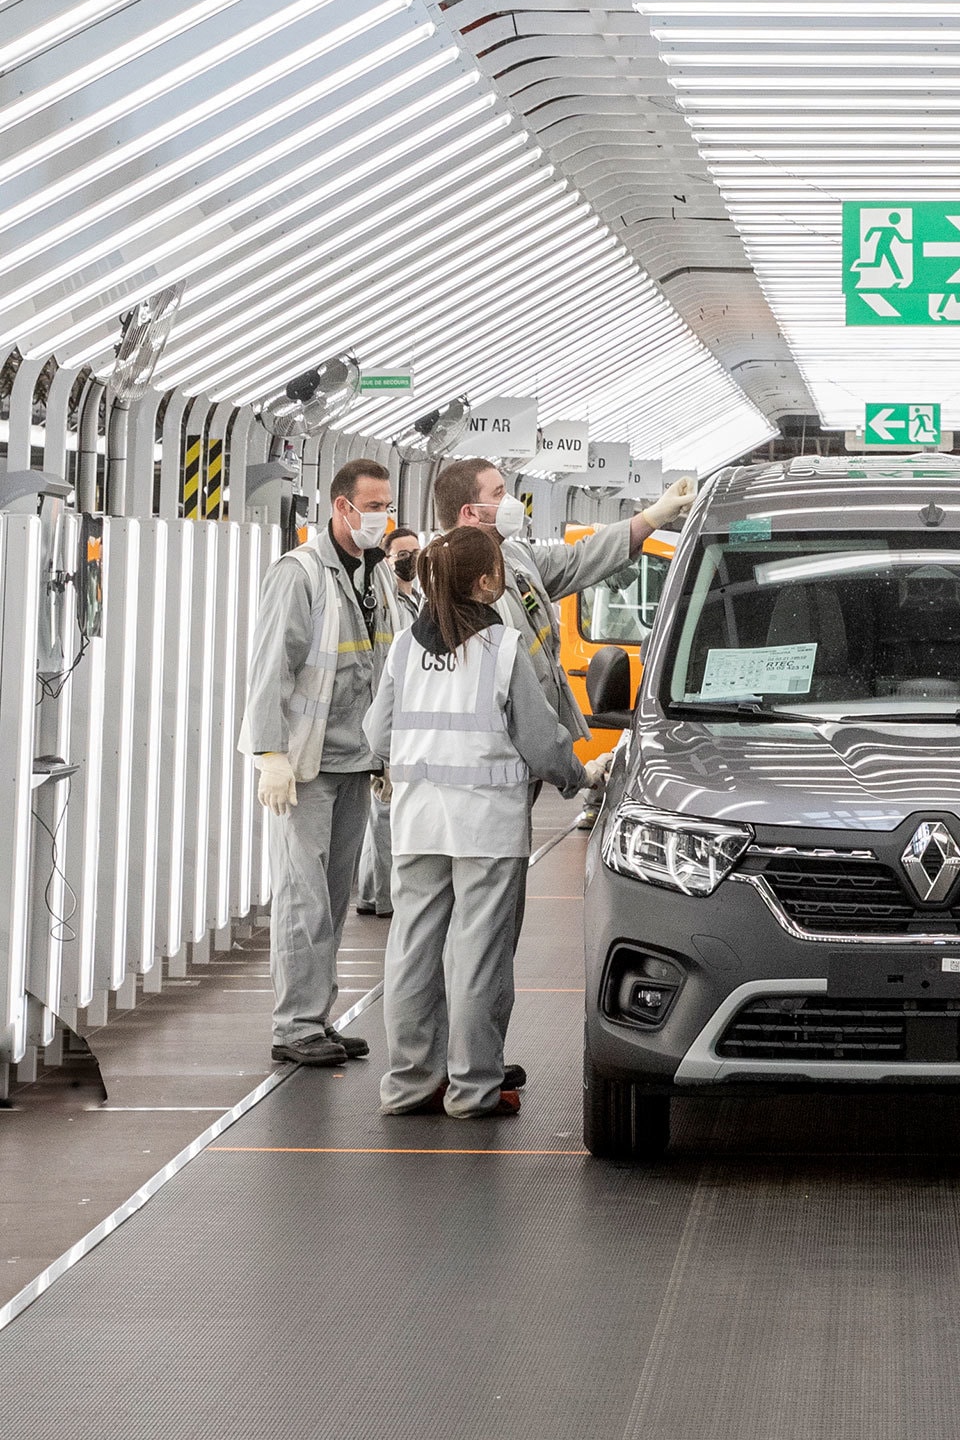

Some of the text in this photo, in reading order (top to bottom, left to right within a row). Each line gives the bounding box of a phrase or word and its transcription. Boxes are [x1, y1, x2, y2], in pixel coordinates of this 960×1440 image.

[491, 418, 511, 432] AR
[557, 438, 582, 451] AVD
[598, 458, 606, 468] D
[634, 474, 641, 483] D
[421, 648, 456, 672] CSC
